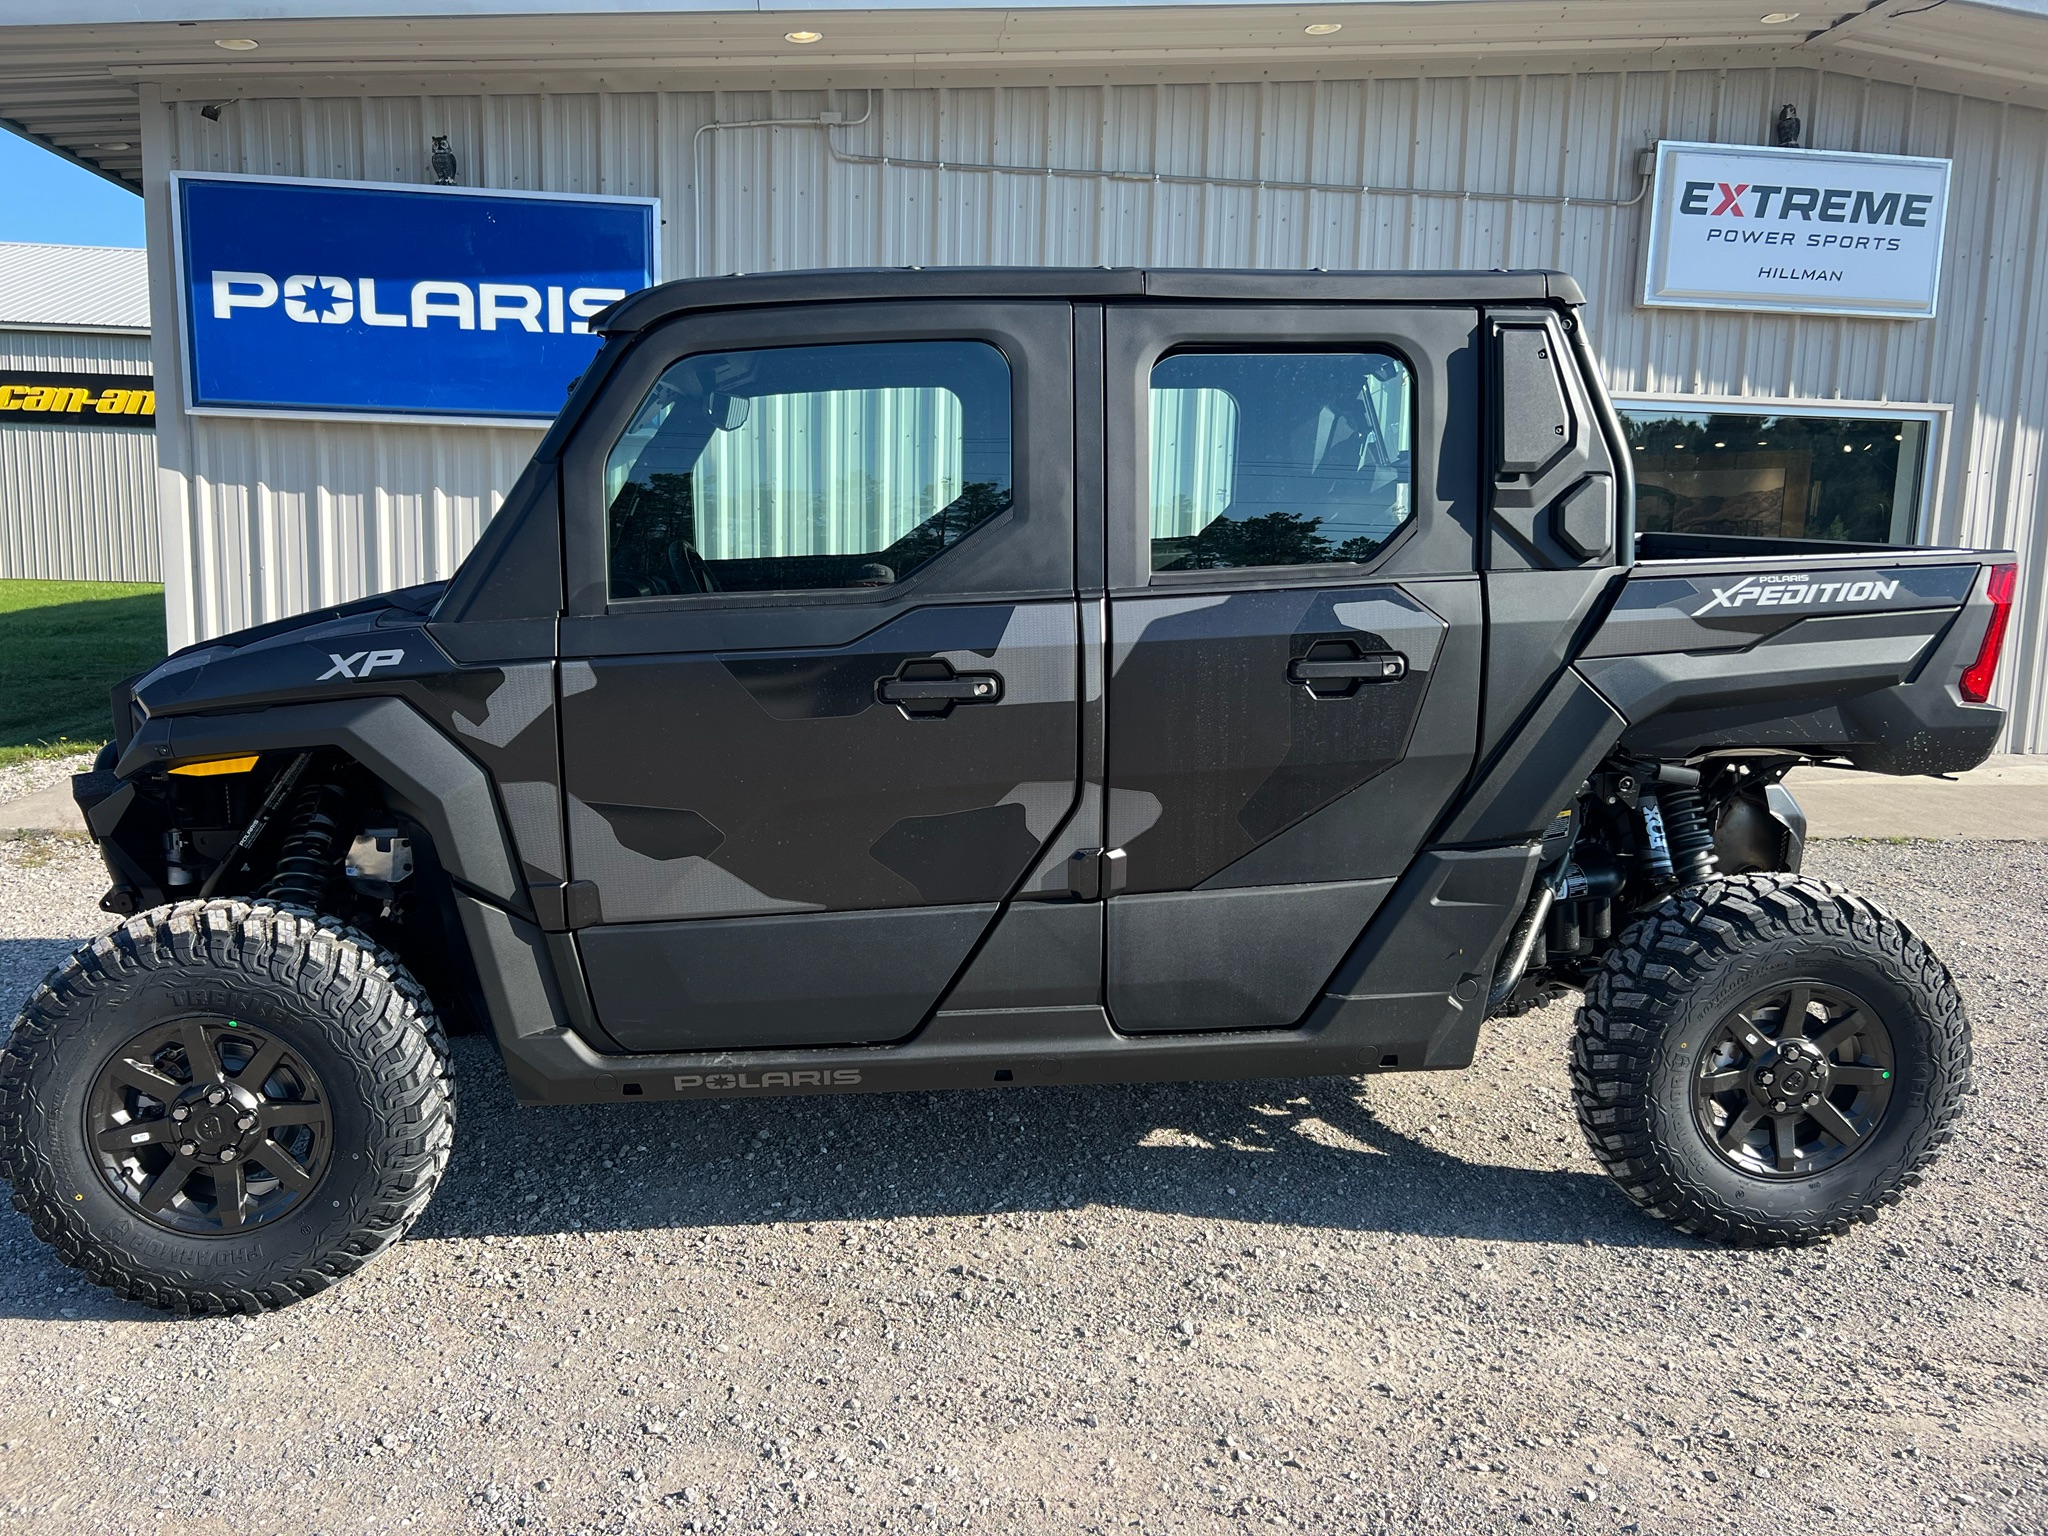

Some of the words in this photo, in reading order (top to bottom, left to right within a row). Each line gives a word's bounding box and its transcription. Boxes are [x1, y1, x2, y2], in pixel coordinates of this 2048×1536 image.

[1679, 181, 1934, 228] EXTREME
[1706, 229, 1796, 246] POWER
[1806, 234, 1901, 251] SPORTS
[1758, 266, 1844, 282] HILLMAN
[211, 270, 626, 334] POLARIS
[1759, 574, 1810, 584] POLARIS
[1690, 576, 1900, 617] XPEDITION
[315, 648, 405, 681] XP
[673, 1068, 863, 1092] POLARIS
